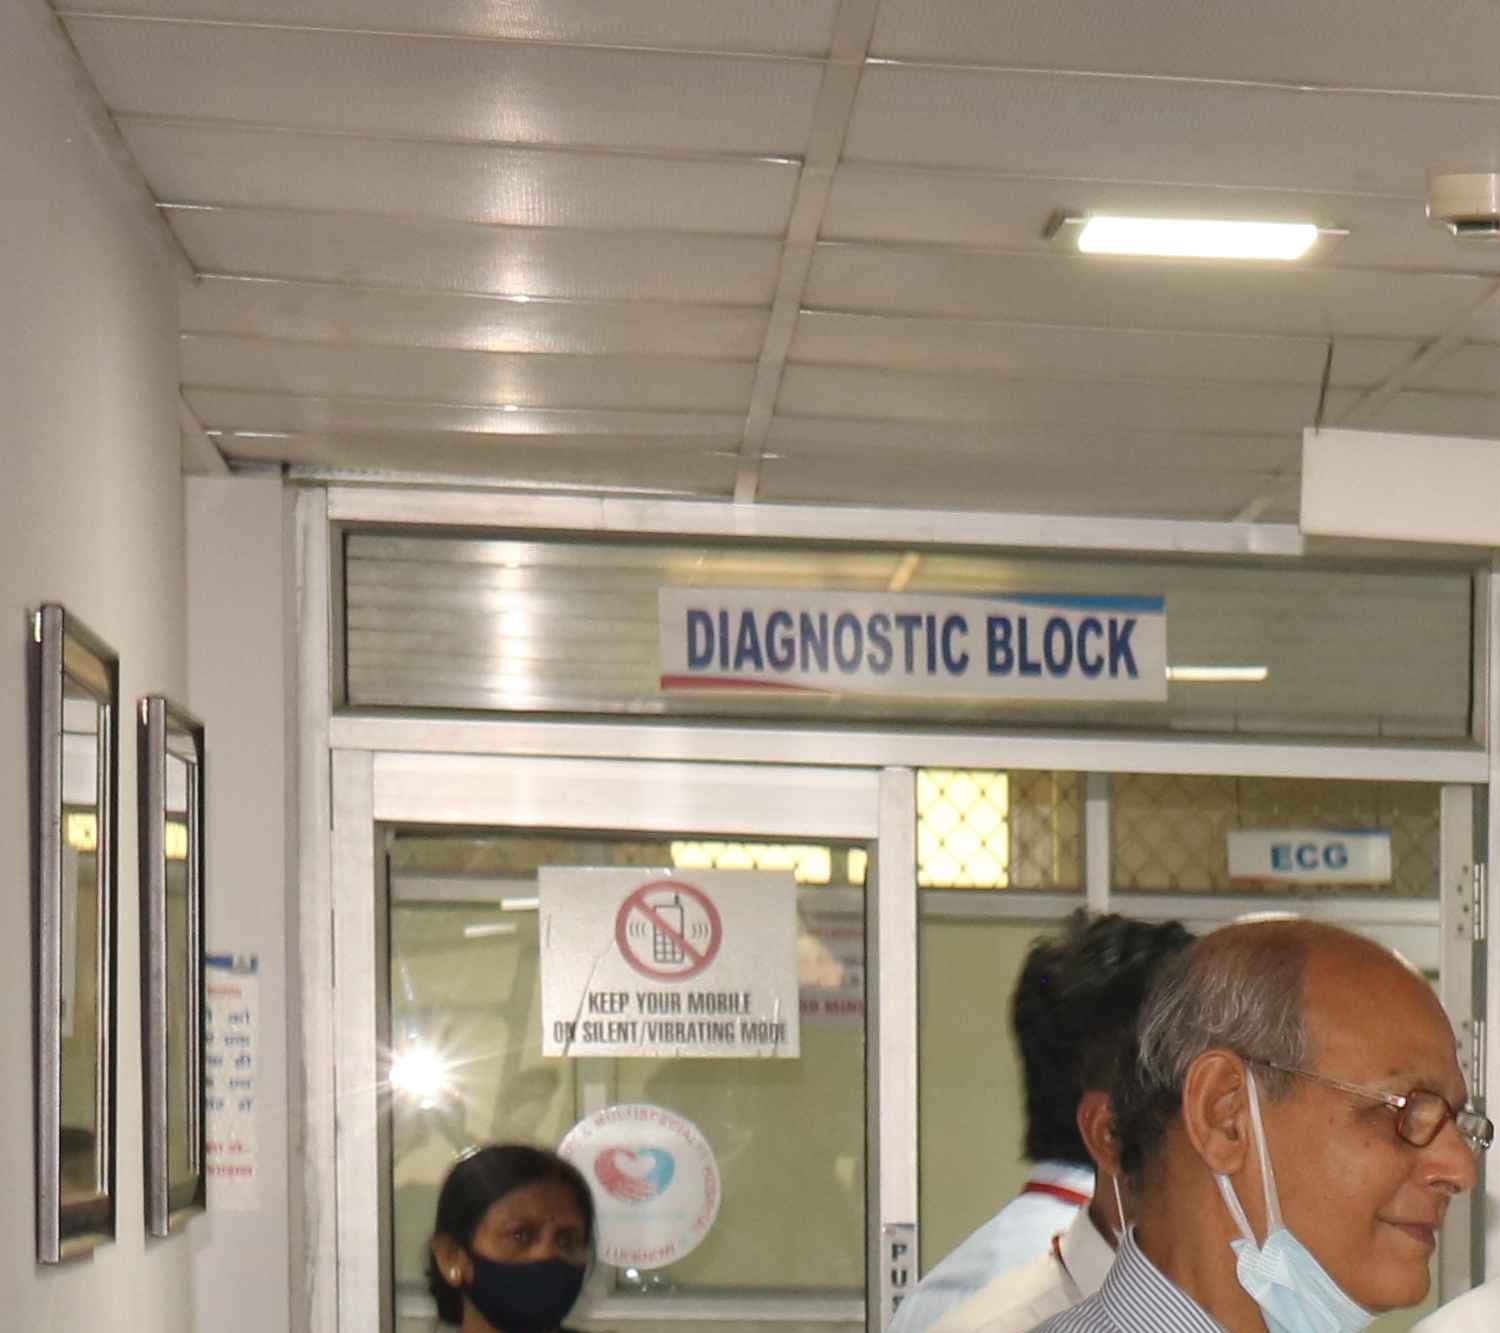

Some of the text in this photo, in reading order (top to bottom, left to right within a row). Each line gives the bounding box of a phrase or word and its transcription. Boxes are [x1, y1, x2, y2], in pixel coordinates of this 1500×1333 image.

[686, 608, 1139, 680] DIAGNOSTIC BLOCK
[1269, 842, 1349, 872] ECG
[588, 992, 751, 1014] KEEP YOUR MOBILE
[554, 1020, 789, 1045] ON SILENT/VIBRATING MODE
